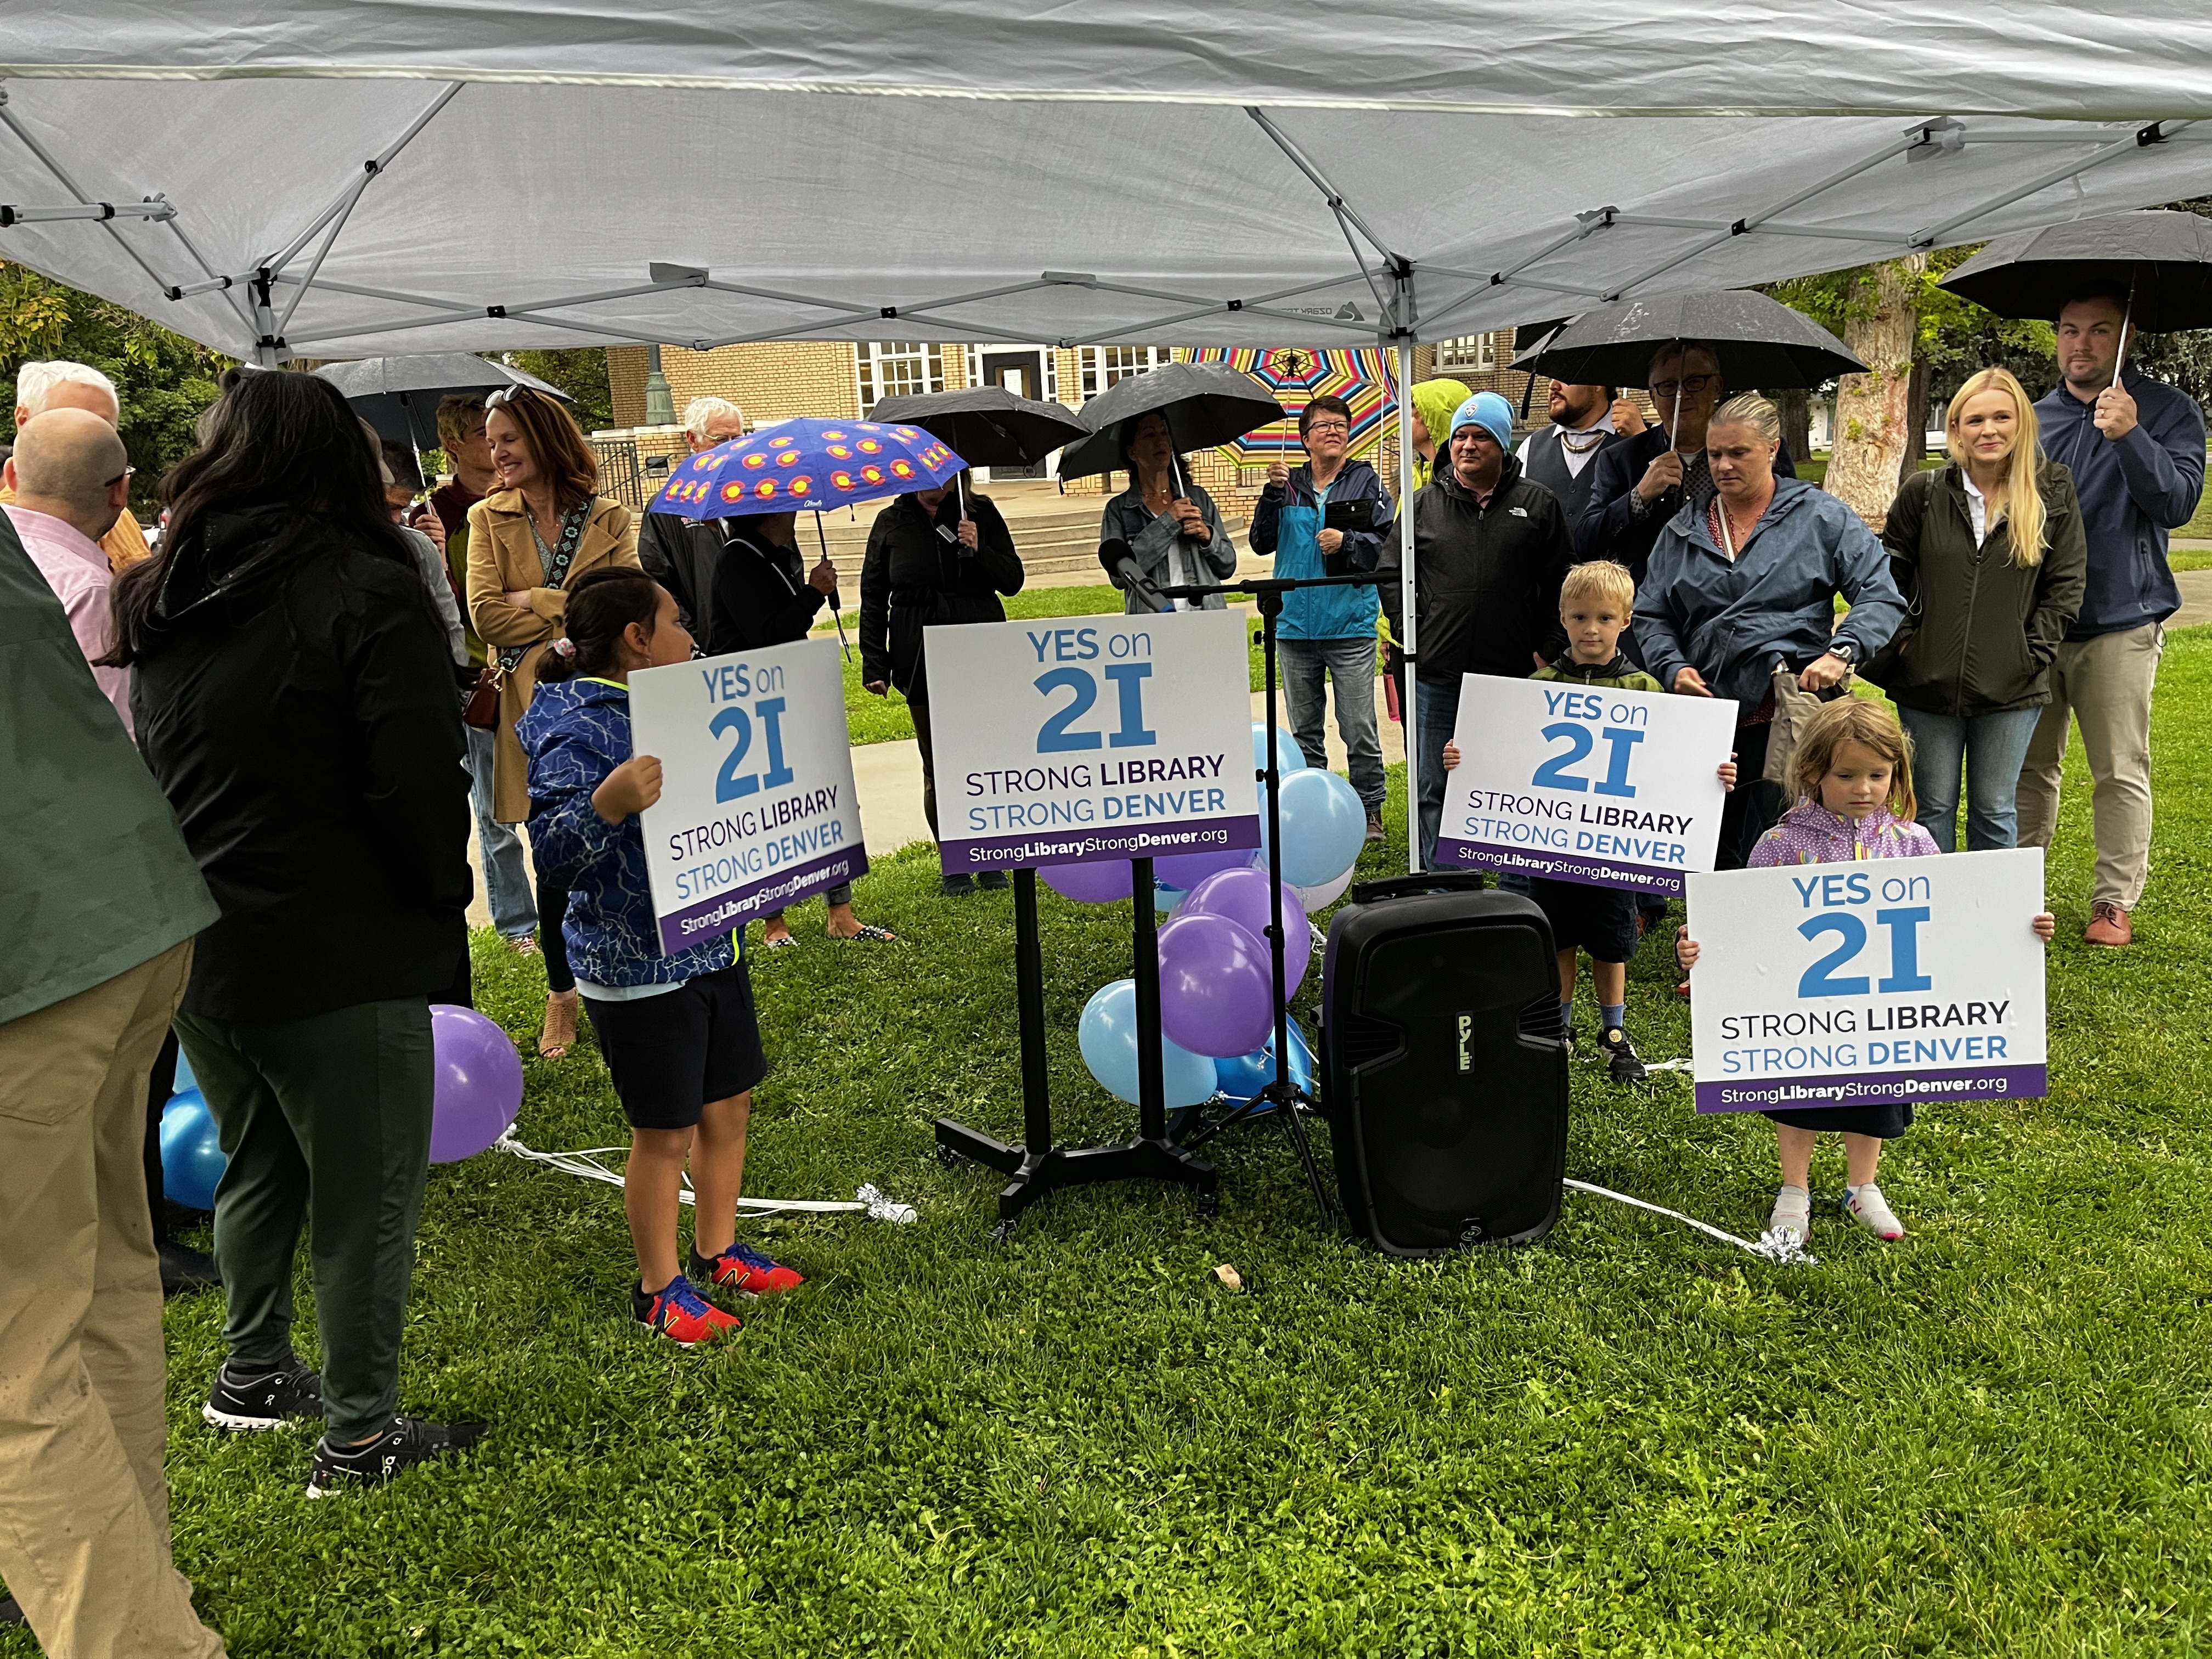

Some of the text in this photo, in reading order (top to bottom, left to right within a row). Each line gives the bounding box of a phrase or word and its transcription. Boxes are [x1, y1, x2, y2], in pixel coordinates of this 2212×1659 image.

[1026, 628, 1151, 662] YES on
[702, 664, 784, 703] YES on
[1034, 662, 1156, 753] 2I
[1544, 690, 1647, 725] YES on
[709, 697, 793, 804] 2I
[1532, 723, 1644, 798] 2I
[967, 754, 1224, 796] STRONG LIBRARY
[670, 783, 837, 860] STRONG LIBRARY
[969, 788, 1226, 831] STRONG DENVER
[1468, 791, 1693, 835] STRONG LIBRARY
[676, 820, 843, 899] STRONG DENVER
[970, 830, 1227, 861] StrongLibraryStrongDenver.org
[1464, 817, 1685, 864] STRONG DENVER
[1459, 848, 1680, 891] StrongLibraryStrongDenver.org
[1792, 873, 1929, 907] YES on
[681, 861, 848, 934] StrongLibraryStrongDenver.org
[1797, 906, 1931, 998] 2I
[1722, 1001, 2010, 1039] STRONG LIBRARY
[1723, 1036, 2007, 1073] STRONG DENVER
[1722, 1079, 2006, 1104] StrongLibraryStrongDenver.org
